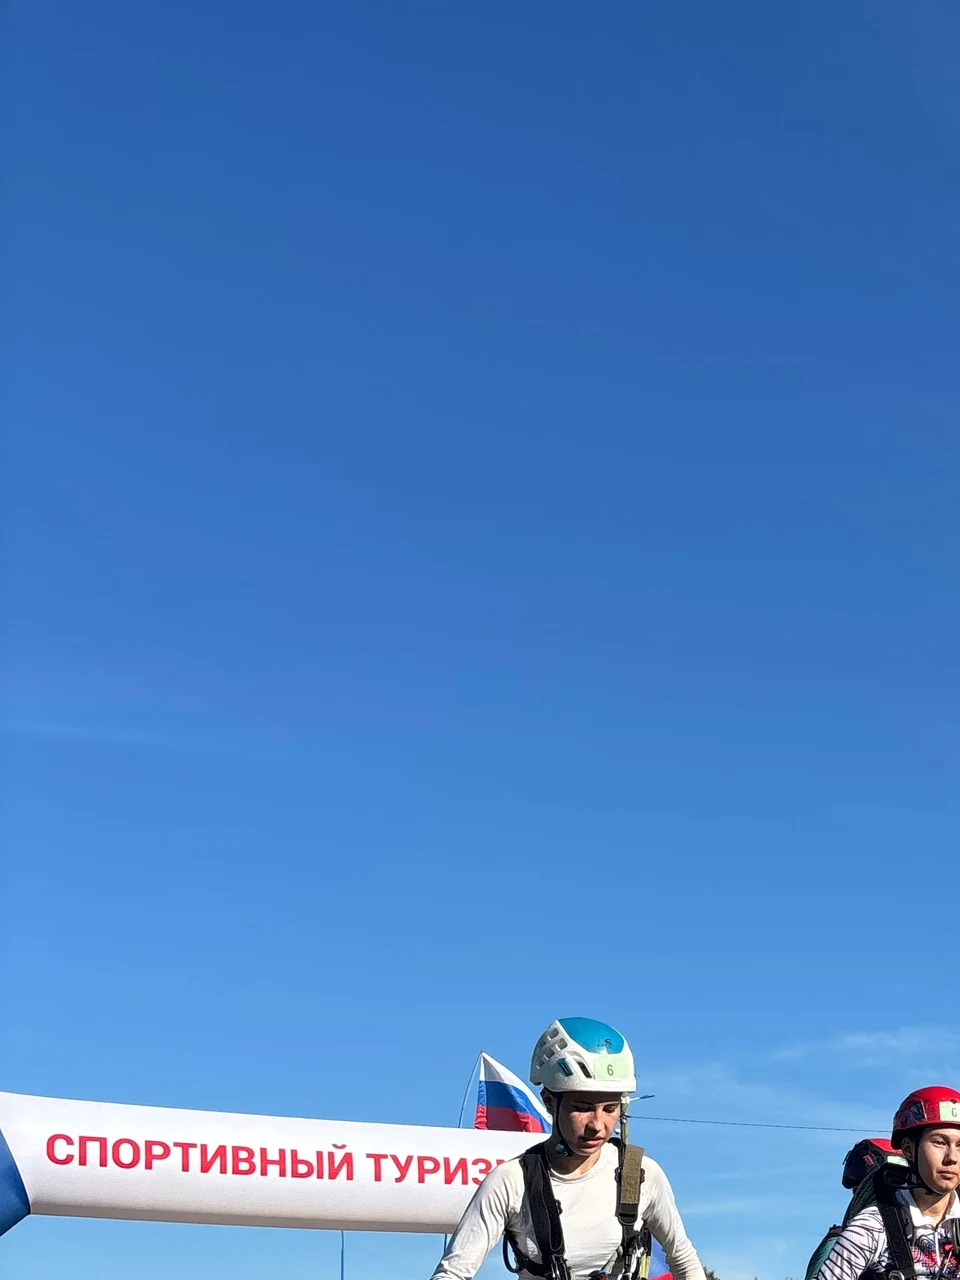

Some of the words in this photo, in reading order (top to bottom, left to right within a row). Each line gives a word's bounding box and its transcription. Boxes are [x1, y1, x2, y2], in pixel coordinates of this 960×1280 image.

[607, 1064, 614, 1076] 6
[46, 1133, 354, 1181] СПОРТИВНЫЙ
[366, 1153, 505, 1186] ТУРИЗ
